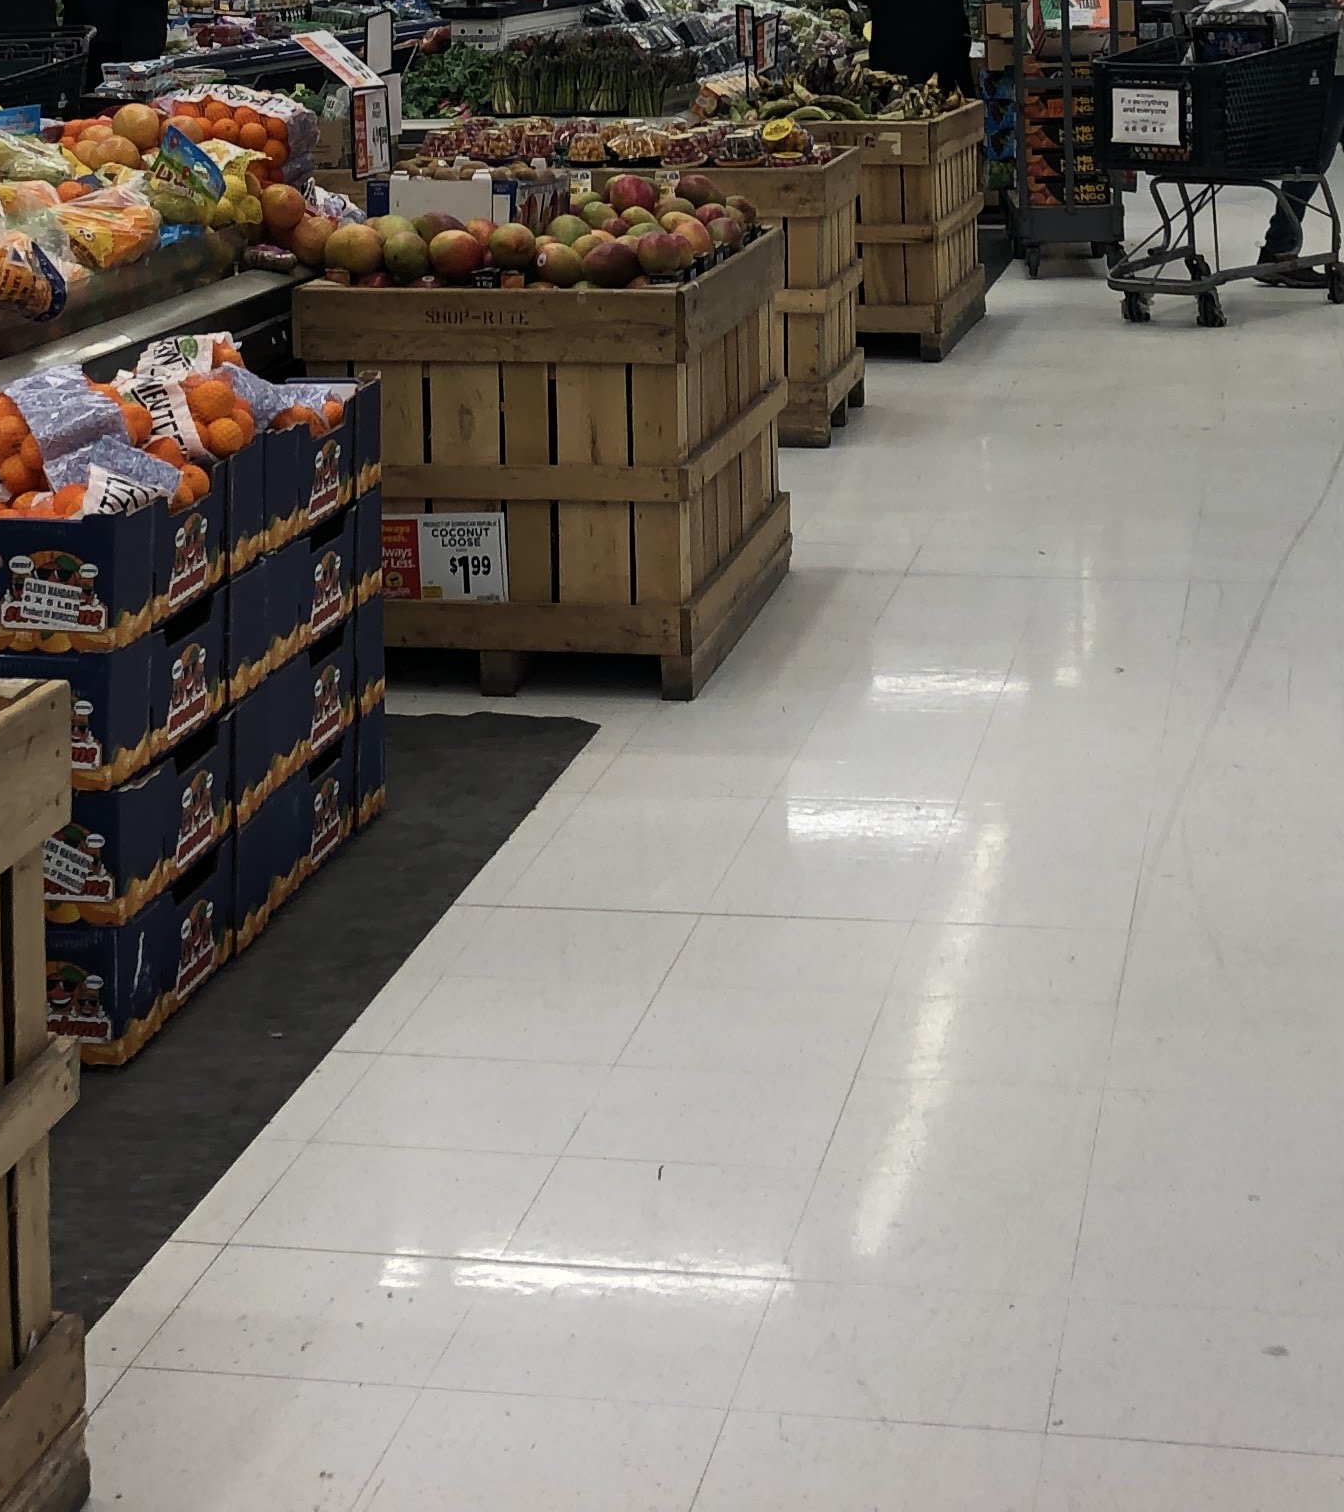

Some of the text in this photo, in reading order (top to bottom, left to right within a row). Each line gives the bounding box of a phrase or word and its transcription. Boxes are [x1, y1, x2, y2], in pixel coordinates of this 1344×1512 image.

[424, 309, 529, 326] SHOP-RITE
[431, 527, 491, 538] COCONUT
[441, 537, 481, 548] LOOSE
[382, 548, 413, 559] lways
